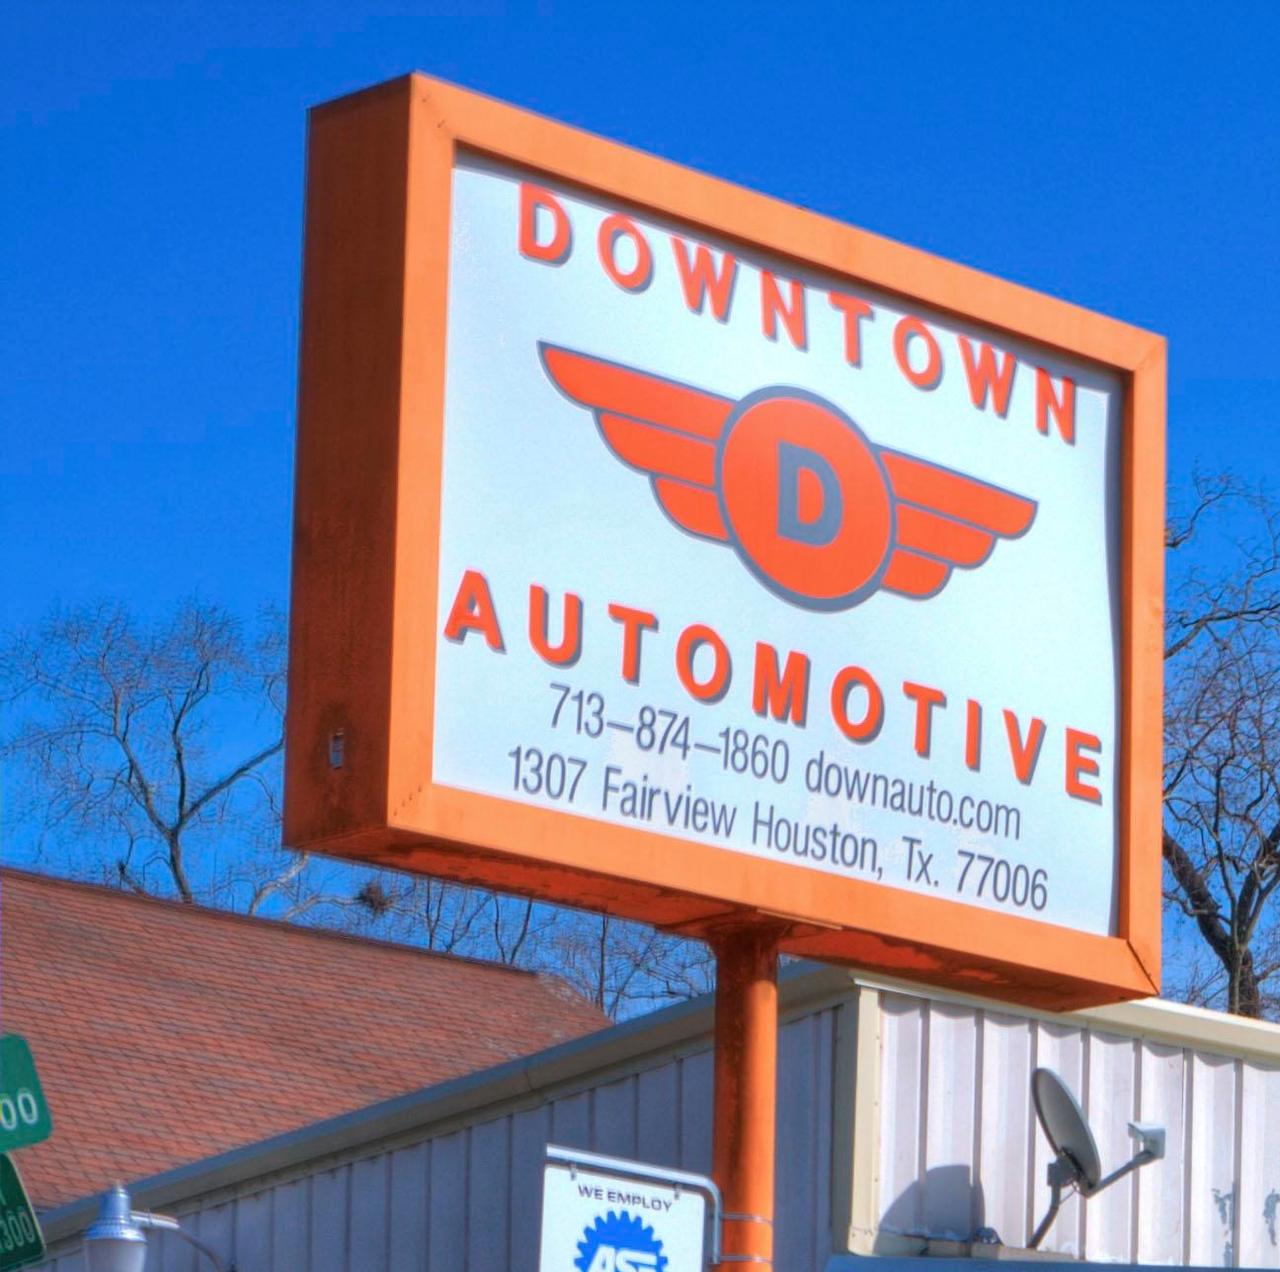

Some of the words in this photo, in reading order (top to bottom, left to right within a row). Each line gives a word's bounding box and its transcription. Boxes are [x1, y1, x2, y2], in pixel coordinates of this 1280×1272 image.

[516, 182, 1078, 444] DOWNTOWN
[775, 439, 845, 548] D
[443, 569, 1104, 804] AUTOMOTIVE
[508, 744, 588, 802] 1307
[601, 763, 738, 840] Fairview
[751, 801, 885, 883] Houston,
[901, 836, 940, 889] Tx.
[955, 850, 1049, 912] 77006
[803, 752, 1022, 840] downauto.com
[578, 1184, 605, 1202] WE
[607, 1191, 673, 1212] EMPLOY
